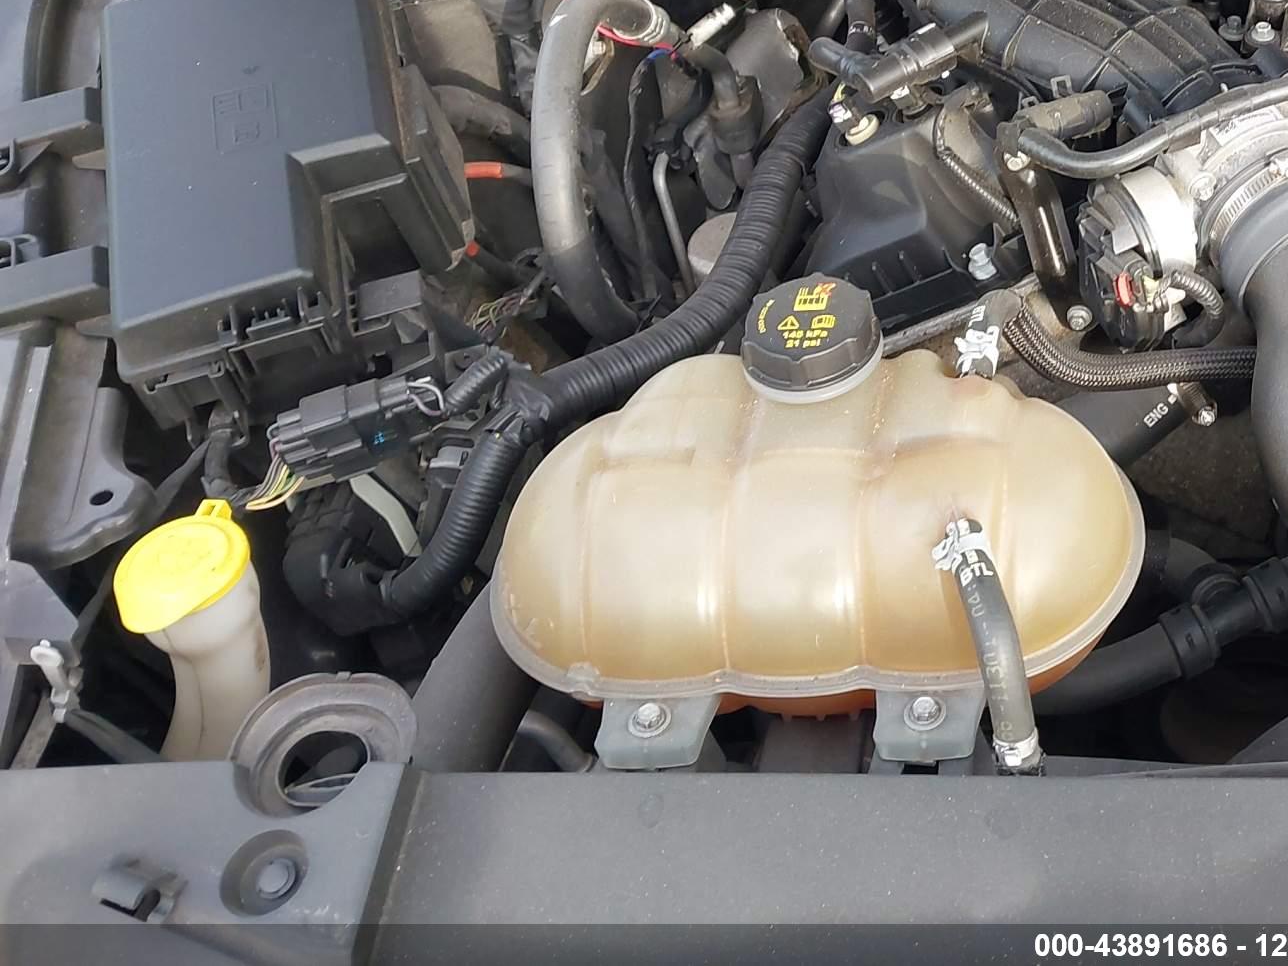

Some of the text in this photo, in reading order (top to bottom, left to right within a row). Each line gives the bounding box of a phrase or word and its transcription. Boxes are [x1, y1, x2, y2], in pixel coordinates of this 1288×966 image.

[802, 338, 821, 349] psi
[1143, 402, 1169, 428] ENG
[959, 561, 994, 587] BTL
